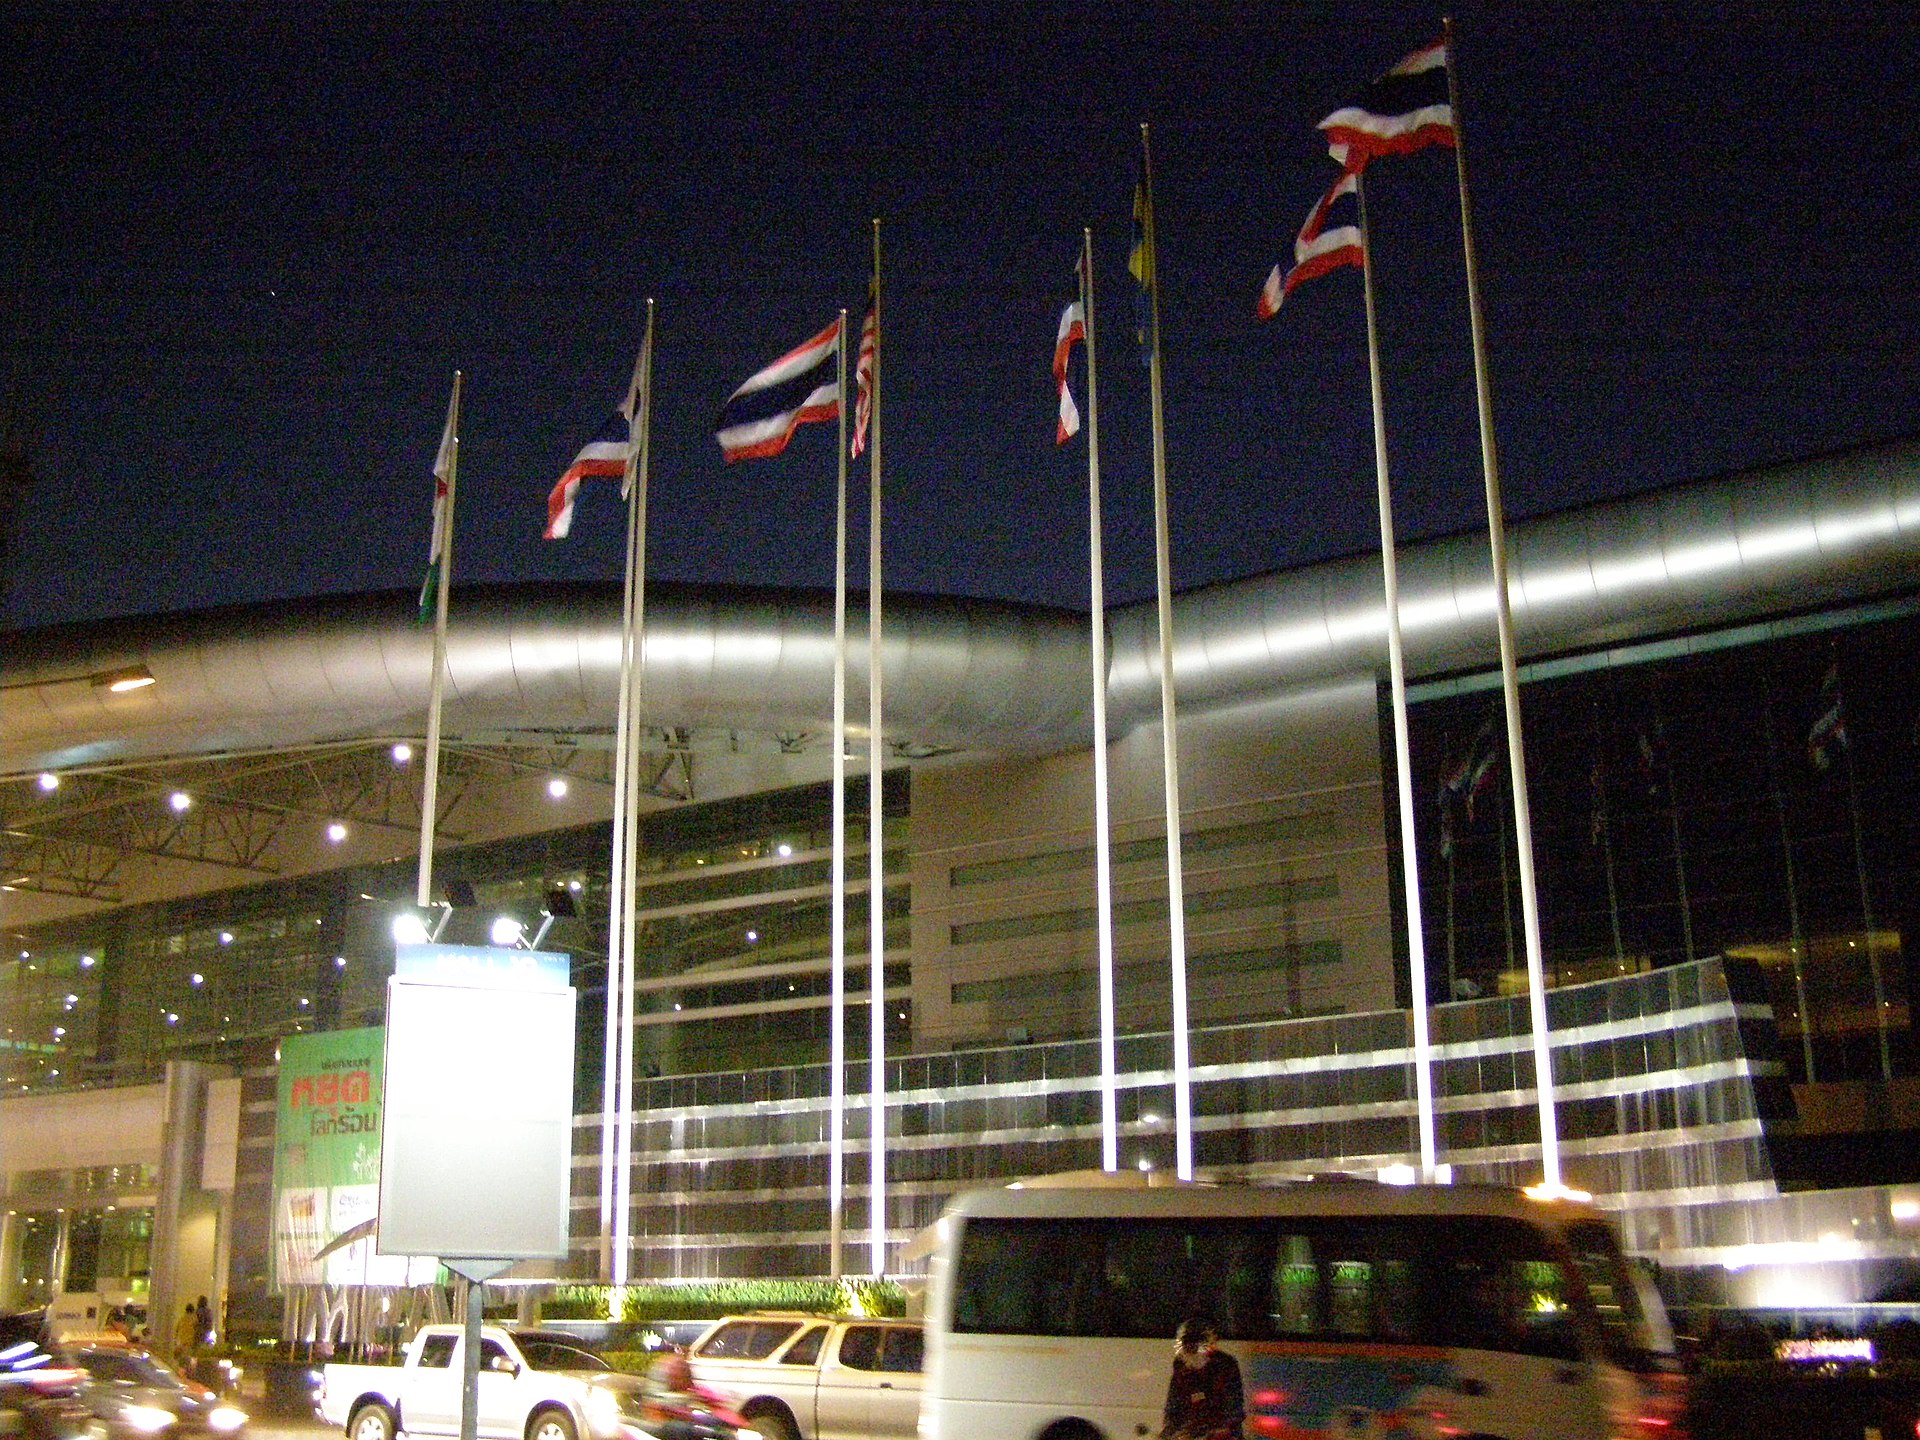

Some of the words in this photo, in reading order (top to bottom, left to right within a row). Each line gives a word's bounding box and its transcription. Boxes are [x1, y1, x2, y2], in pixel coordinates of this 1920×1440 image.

[291, 1071, 370, 1119] หยุด
[311, 1105, 377, 1136] โลกร้อน
